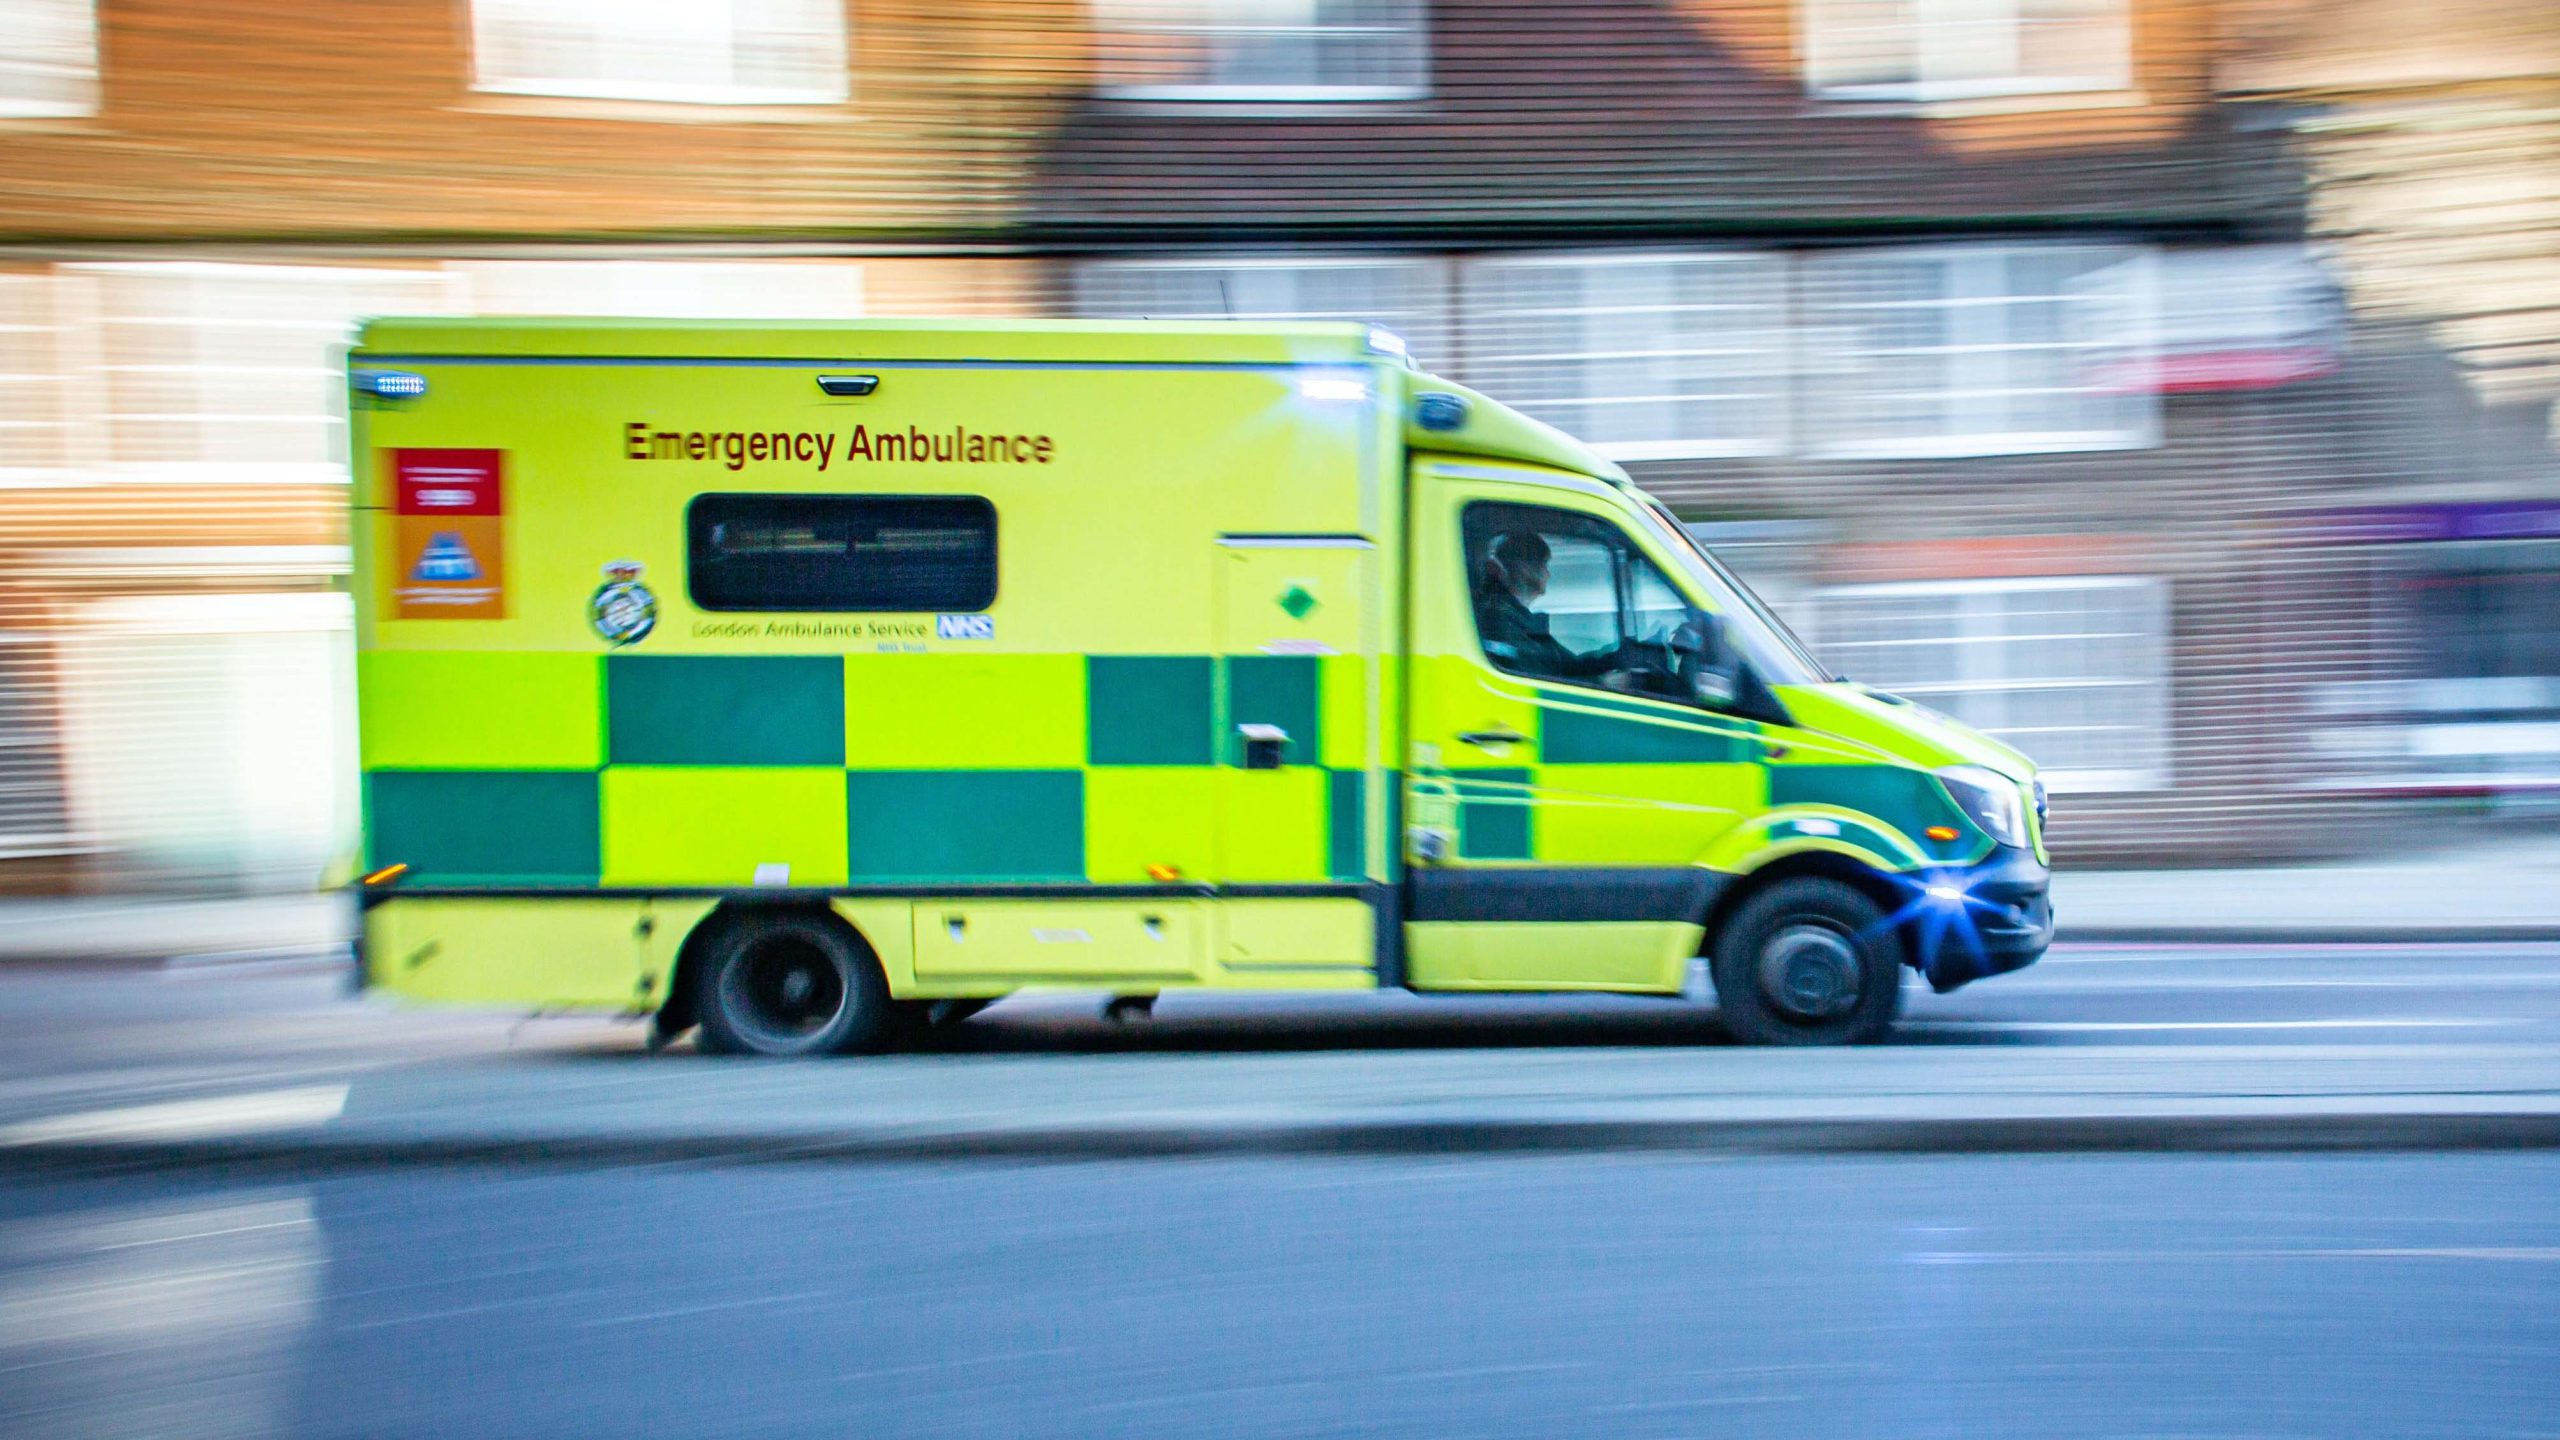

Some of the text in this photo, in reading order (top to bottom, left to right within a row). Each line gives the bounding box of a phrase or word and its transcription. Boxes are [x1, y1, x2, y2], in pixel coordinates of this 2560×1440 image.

[625, 423, 1056, 471] Emergency Ambulance
[691, 621, 927, 638] London Ambulance Service
[938, 614, 993, 639] NHS
